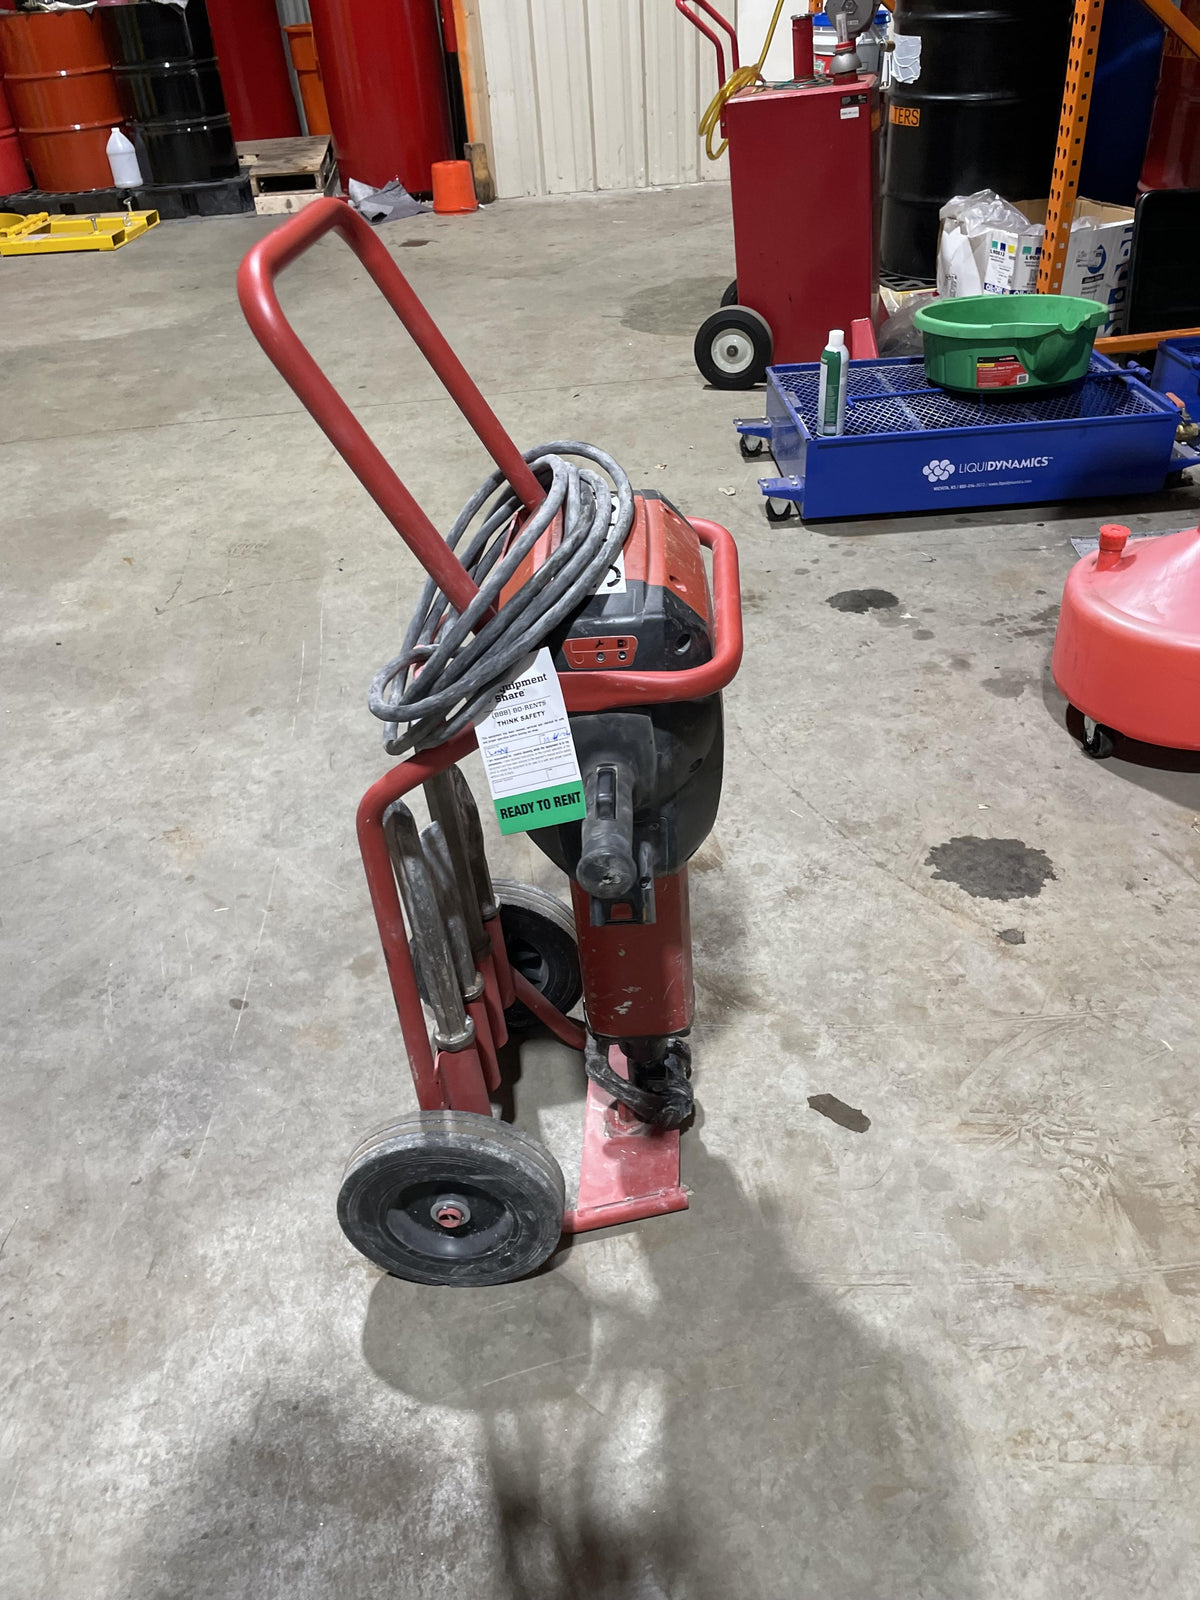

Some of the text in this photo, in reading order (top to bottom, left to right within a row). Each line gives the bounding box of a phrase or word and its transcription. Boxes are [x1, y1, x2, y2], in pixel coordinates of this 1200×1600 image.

[497, 673, 548, 694] quipment
[495, 690, 525, 703] Share
[497, 710, 545, 727] THINK SAFETY
[500, 791, 581, 819] READY TO RENT
